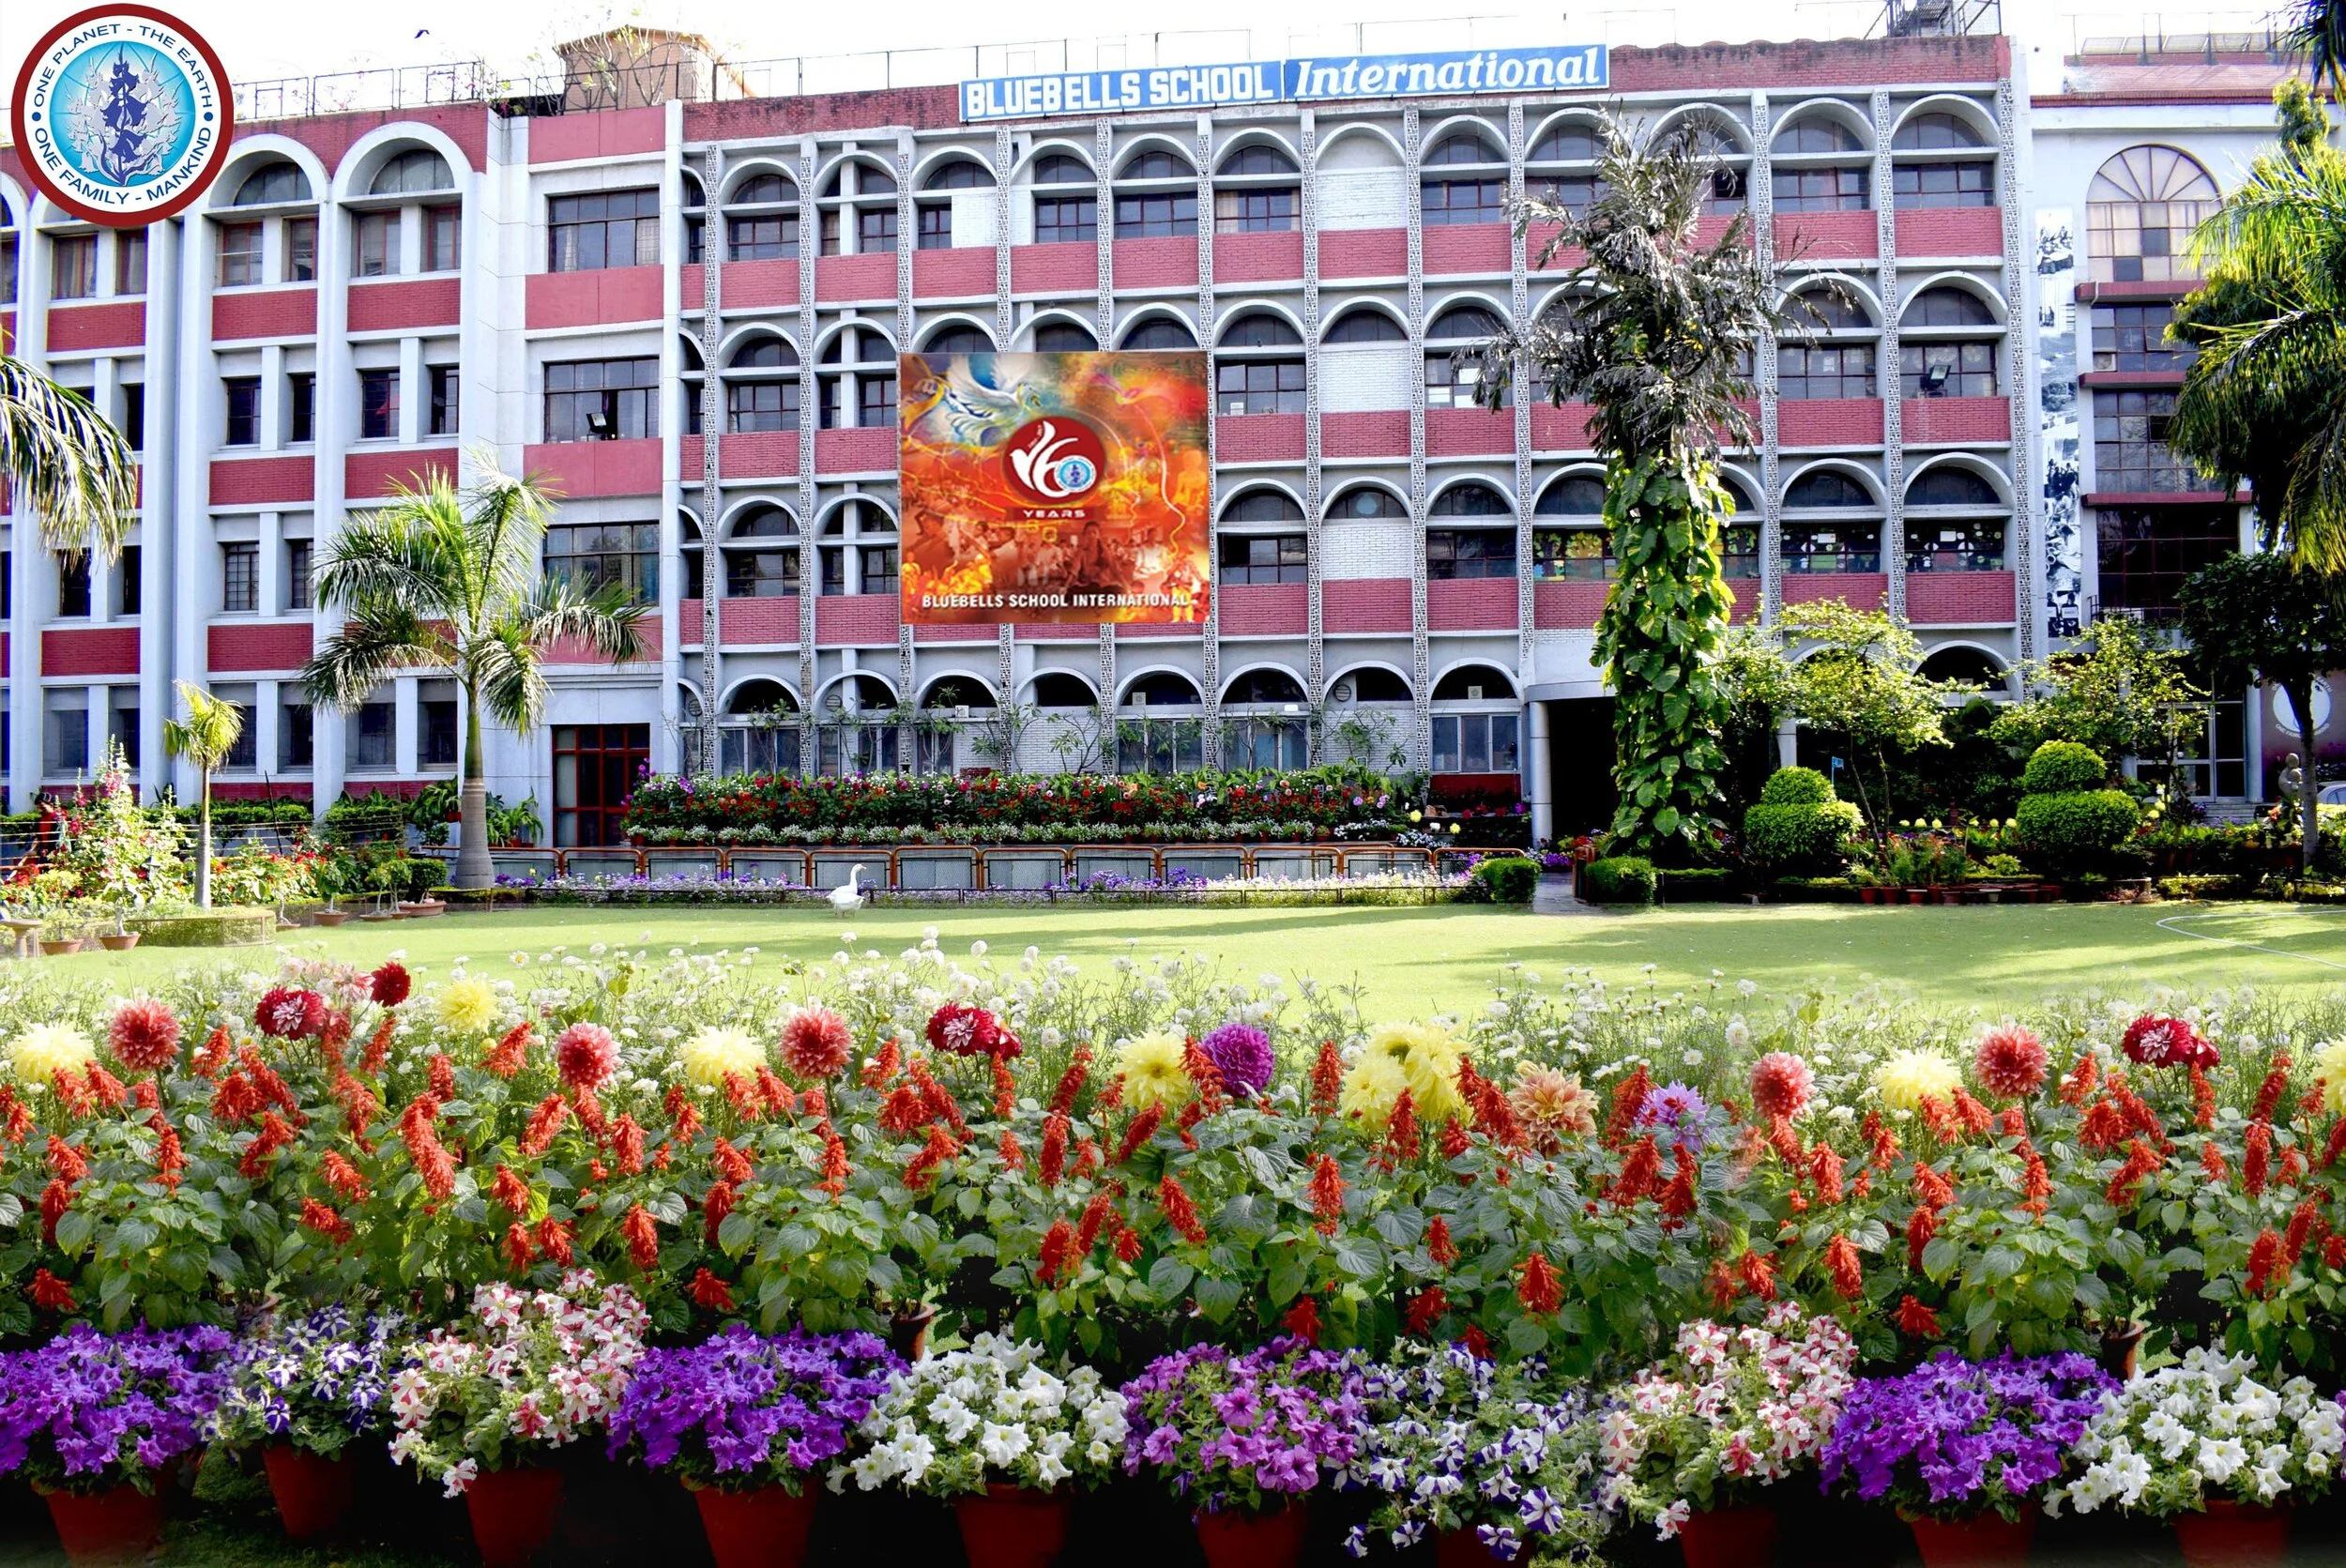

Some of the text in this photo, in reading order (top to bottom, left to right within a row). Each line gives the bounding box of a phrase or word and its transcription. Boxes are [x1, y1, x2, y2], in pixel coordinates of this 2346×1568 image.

[967, 48, 1600, 117] BLUEBELLS SCHOOL International
[1023, 510, 1086, 518] YEARS
[922, 593, 1188, 609] BLUEBELLS SCHOOL INTERNATIONAL
